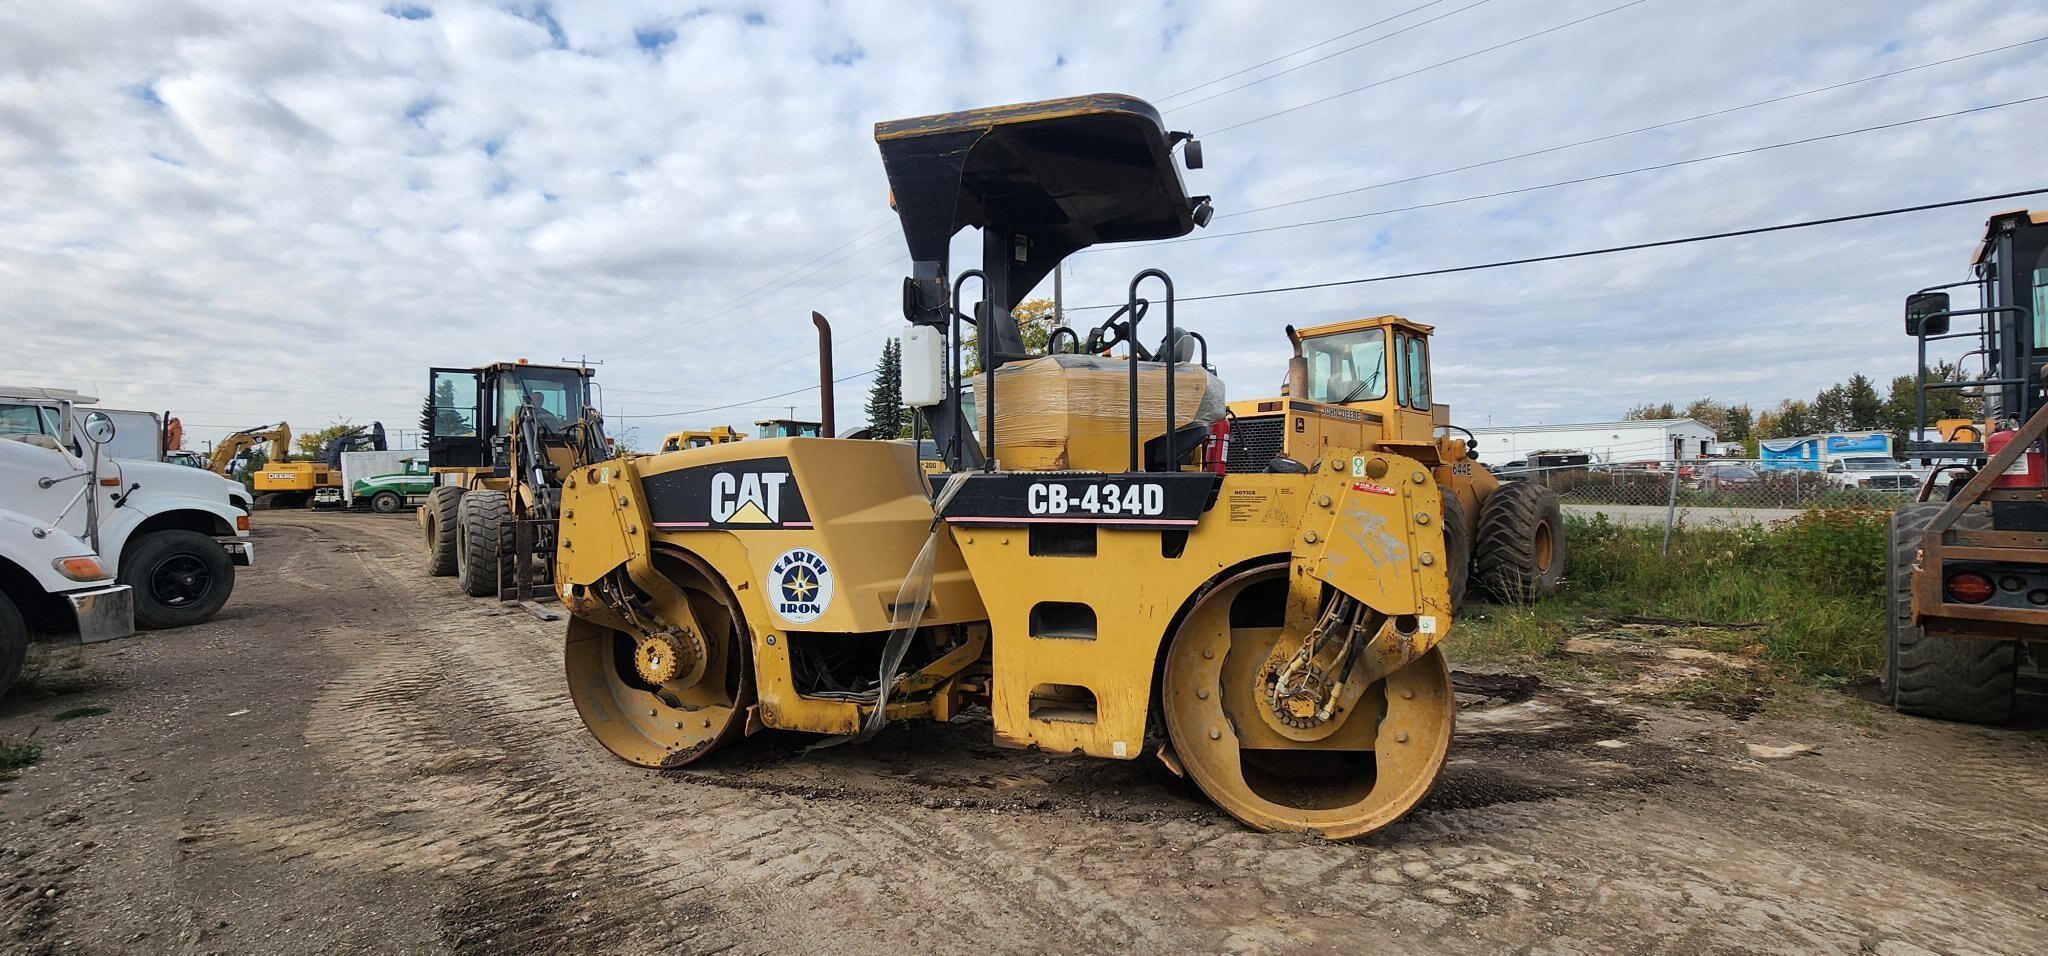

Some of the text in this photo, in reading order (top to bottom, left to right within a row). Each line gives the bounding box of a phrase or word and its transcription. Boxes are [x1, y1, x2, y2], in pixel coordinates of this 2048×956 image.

[1341, 409, 1361, 421] DEERE
[354, 436, 370, 445] DEERE
[1452, 463, 1472, 476] 644E
[711, 472, 786, 523] CAT
[1028, 483, 1165, 516] CB-434D
[774, 551, 828, 575] EARTH
[780, 603, 820, 613] IRON
